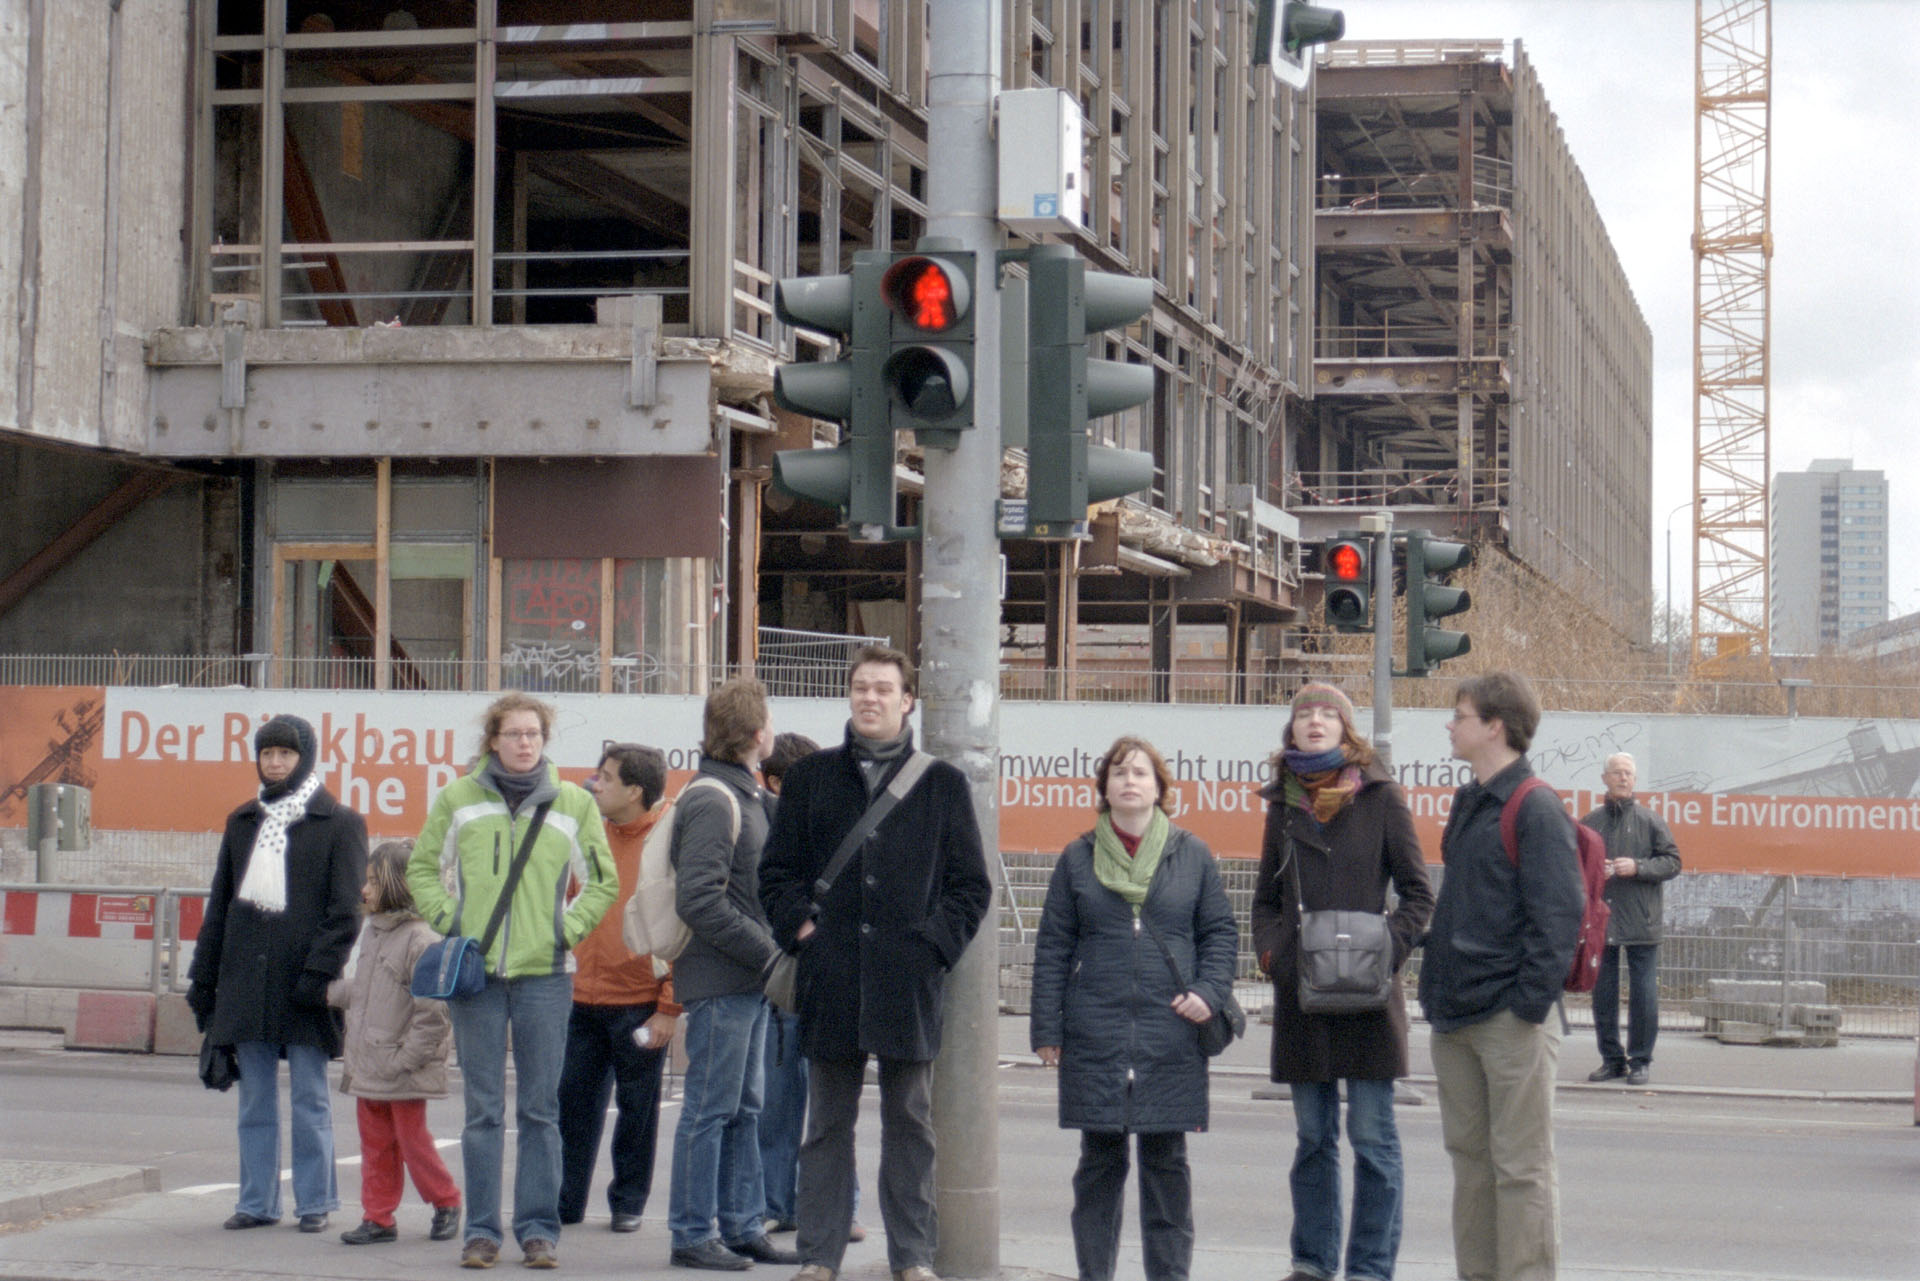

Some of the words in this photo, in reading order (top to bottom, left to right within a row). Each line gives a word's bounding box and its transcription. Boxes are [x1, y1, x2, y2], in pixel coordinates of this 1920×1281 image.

[120, 710, 205, 762] Der
[223, 711, 454, 765] Rkbau
[1197, 780, 1252, 813] Not
[1648, 791, 1701, 824] the
[1711, 793, 1920, 831] Environment
